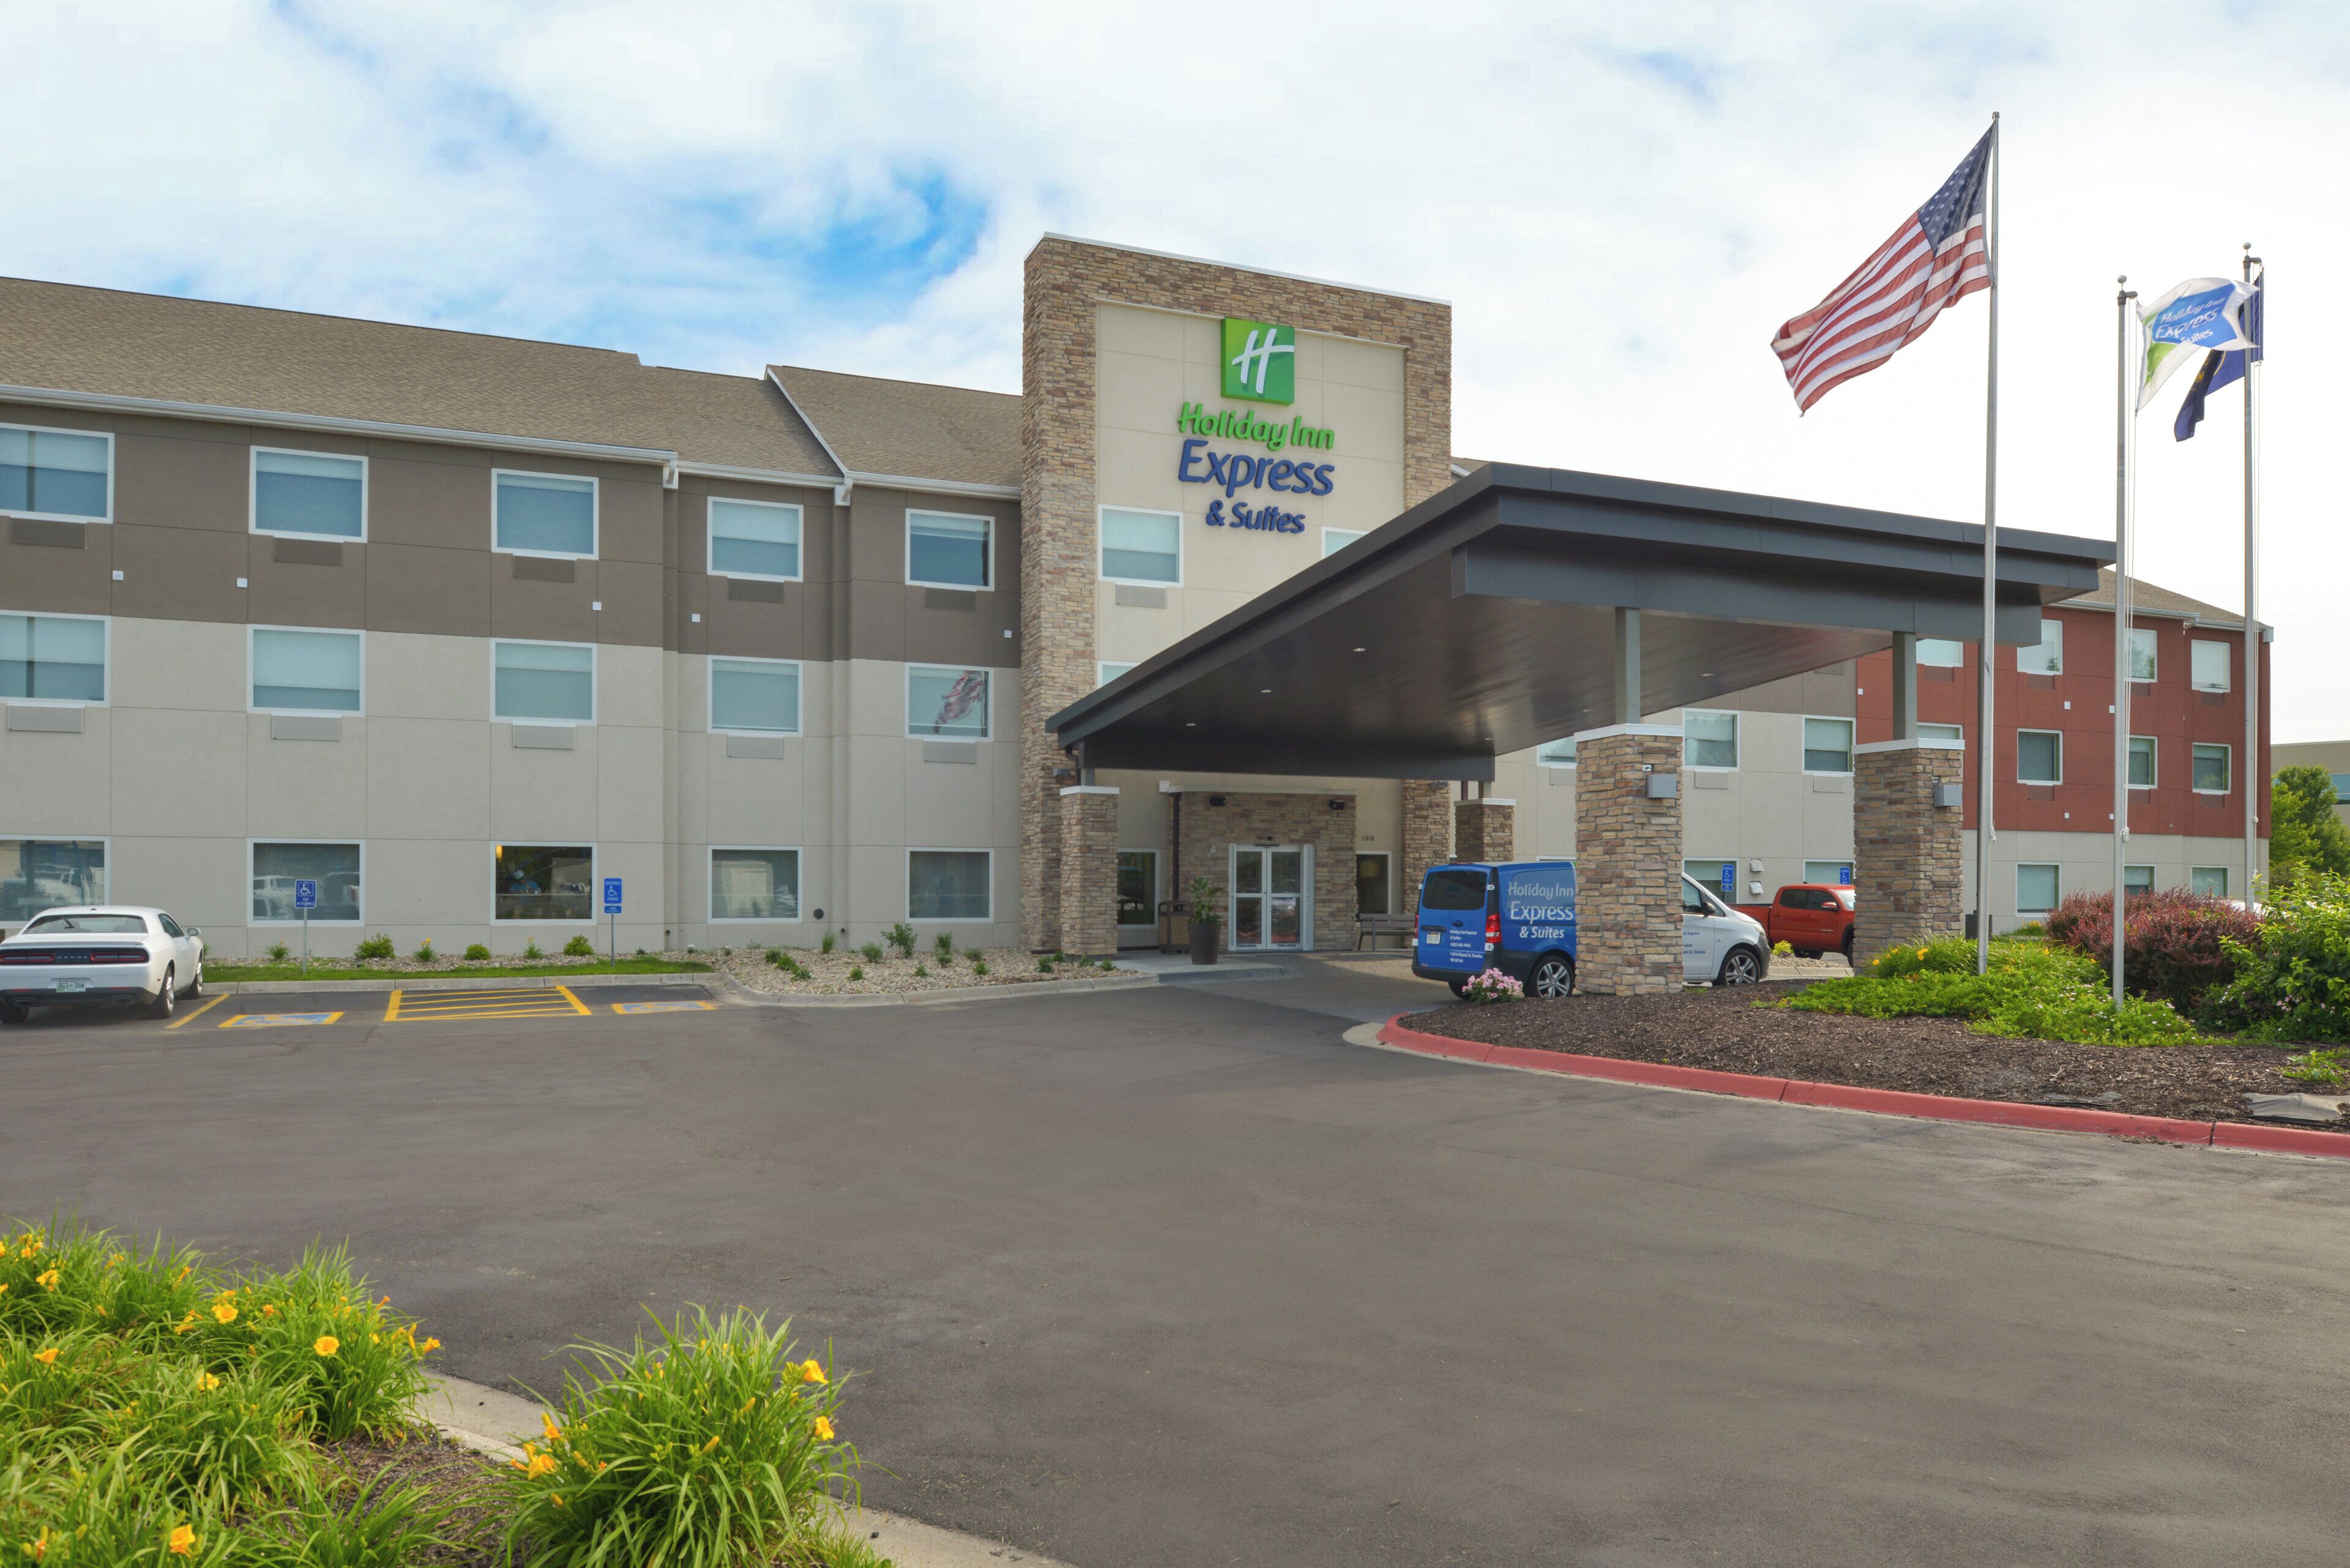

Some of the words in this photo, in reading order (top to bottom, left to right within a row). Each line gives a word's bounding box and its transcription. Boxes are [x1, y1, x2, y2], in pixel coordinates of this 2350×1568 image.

[2155, 307, 2220, 338] Express
[2160, 304, 2205, 323] Holiday
[2204, 297, 2226, 308] Inn
[1177, 402, 1288, 450] Holiday
[1291, 416, 1335, 450] Inn
[1178, 439, 1335, 498] Express
[1206, 500, 1225, 527] &
[1229, 502, 1306, 534] Suites
[1507, 881, 1553, 900] Holiday
[1556, 883, 1573, 897] Inn
[1510, 901, 1573, 924] Express
[1520, 926, 1529, 938] &
[1531, 926, 1564, 938] Suites
